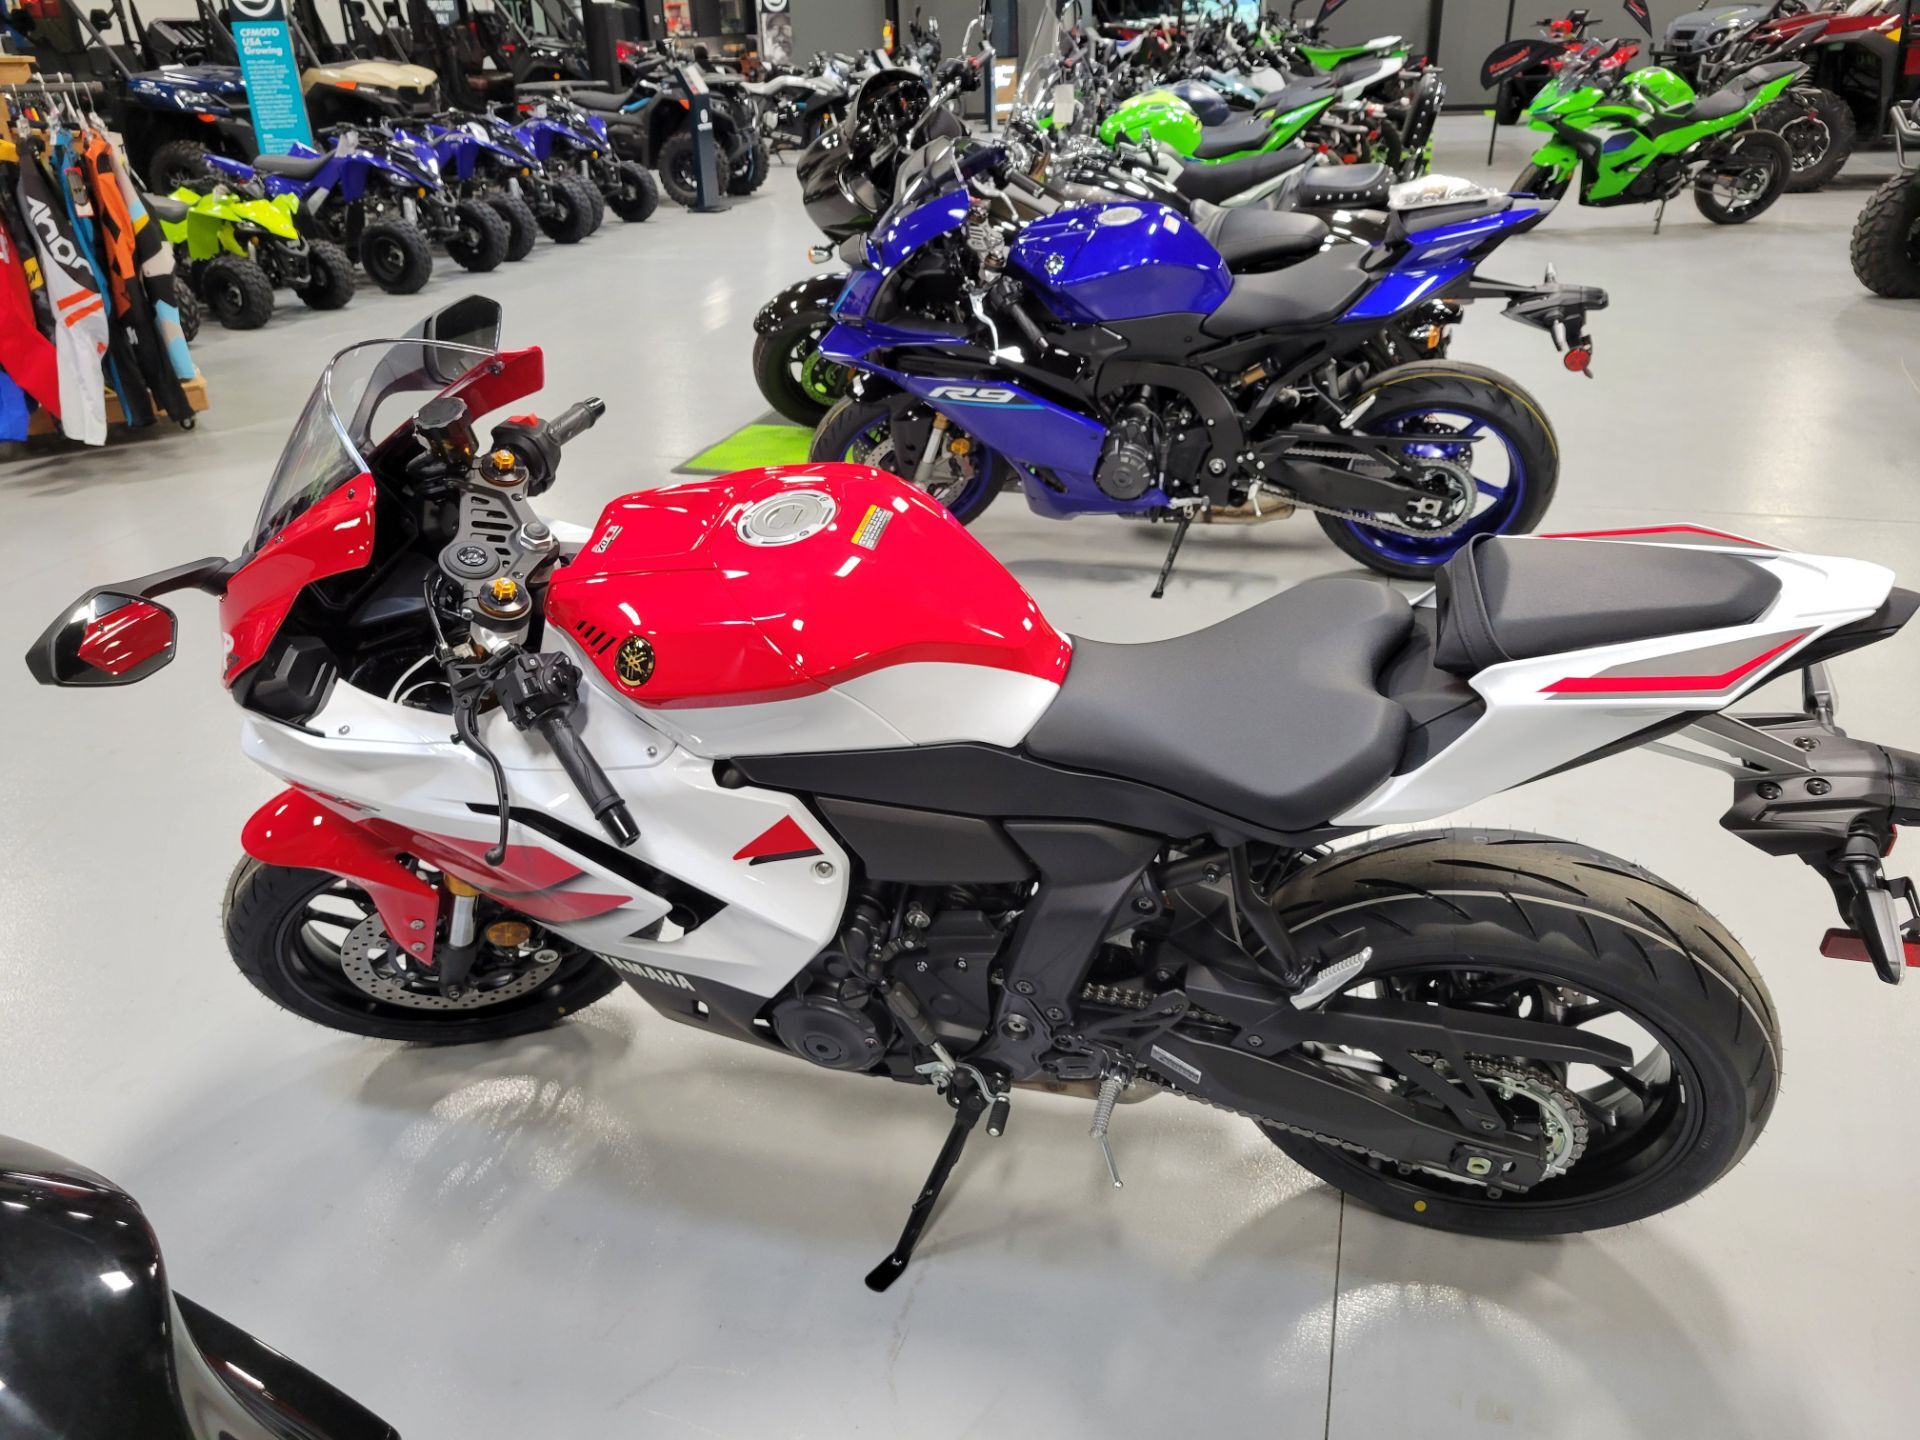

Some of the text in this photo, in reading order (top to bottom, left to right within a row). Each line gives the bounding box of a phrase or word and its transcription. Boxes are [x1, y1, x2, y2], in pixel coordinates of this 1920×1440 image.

[240, 27, 280, 37] CFMOTO
[242, 37, 261, 46] USA
[243, 46, 282, 56] Growing
[928, 385, 1017, 403] R9
[593, 951, 696, 993] YAMAHA
